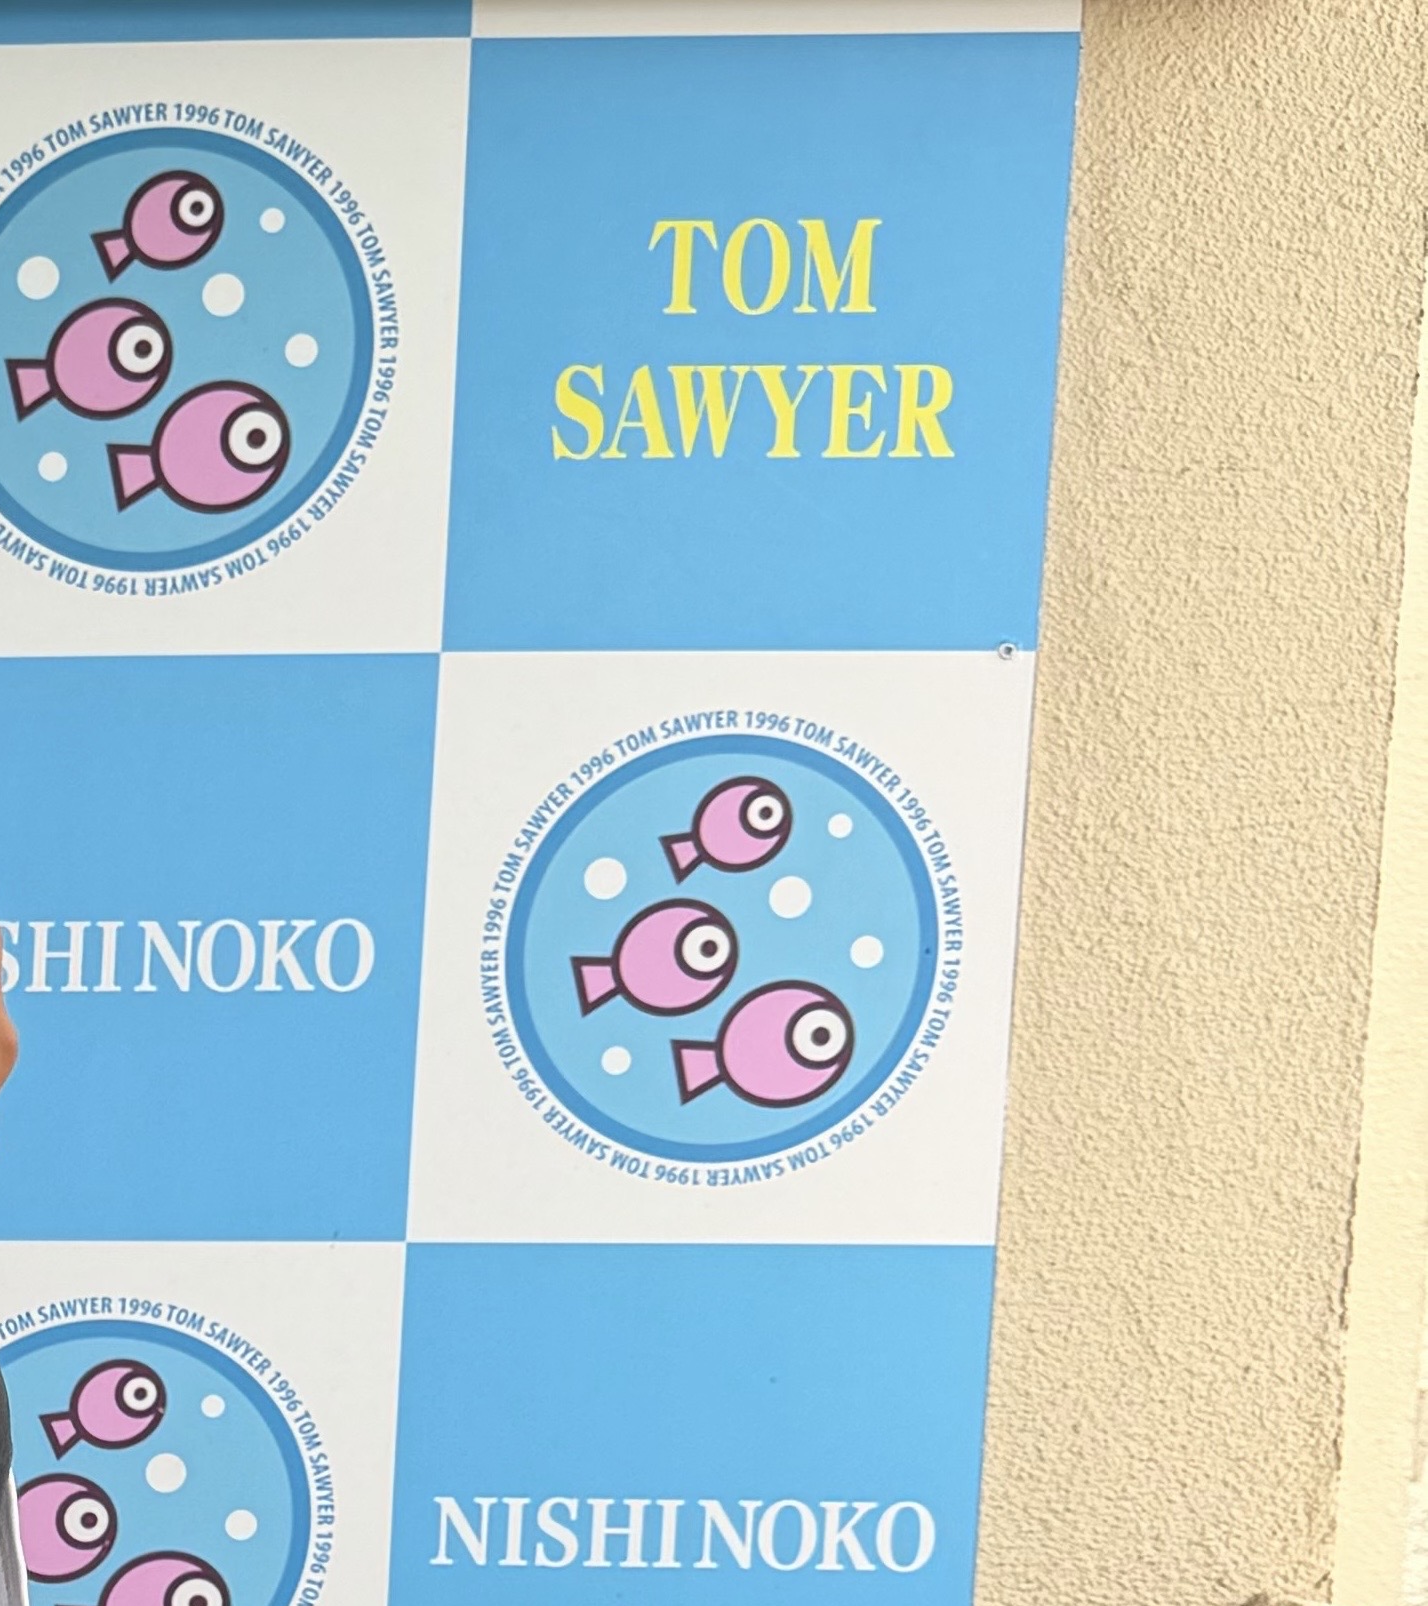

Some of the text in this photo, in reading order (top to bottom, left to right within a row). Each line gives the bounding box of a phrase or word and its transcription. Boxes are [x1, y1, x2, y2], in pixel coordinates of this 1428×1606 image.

[0, 142, 46, 183] 1996
[41, 118, 88, 153] TOM
[87, 101, 168, 134] SAWYER
[172, 101, 221, 126] 1996
[222, 108, 265, 140] TOM
[262, 126, 333, 186] SAWYER
[327, 179, 366, 226] 1996
[354, 221, 386, 268] TOM
[370, 267, 399, 350] SAWYER
[648, 217, 883, 315] TOM
[551, 363, 955, 460] SAWYER
[481, 708, 963, 952] 1996 TOM SAWYER 1996 TOM SAWYER 1996 TOM SAWYER 1996 TOM SAWYER
[35, 1295, 113, 1324] SAWYER
[117, 1296, 163, 1319] 1996
[165, 1303, 206, 1333] TOM
[203, 1320, 272, 1376] SAWYER
[266, 1369, 303, 1413] 1996
[293, 1409, 323, 1452] TOM
[307, 1451, 335, 1526] SAWYER
